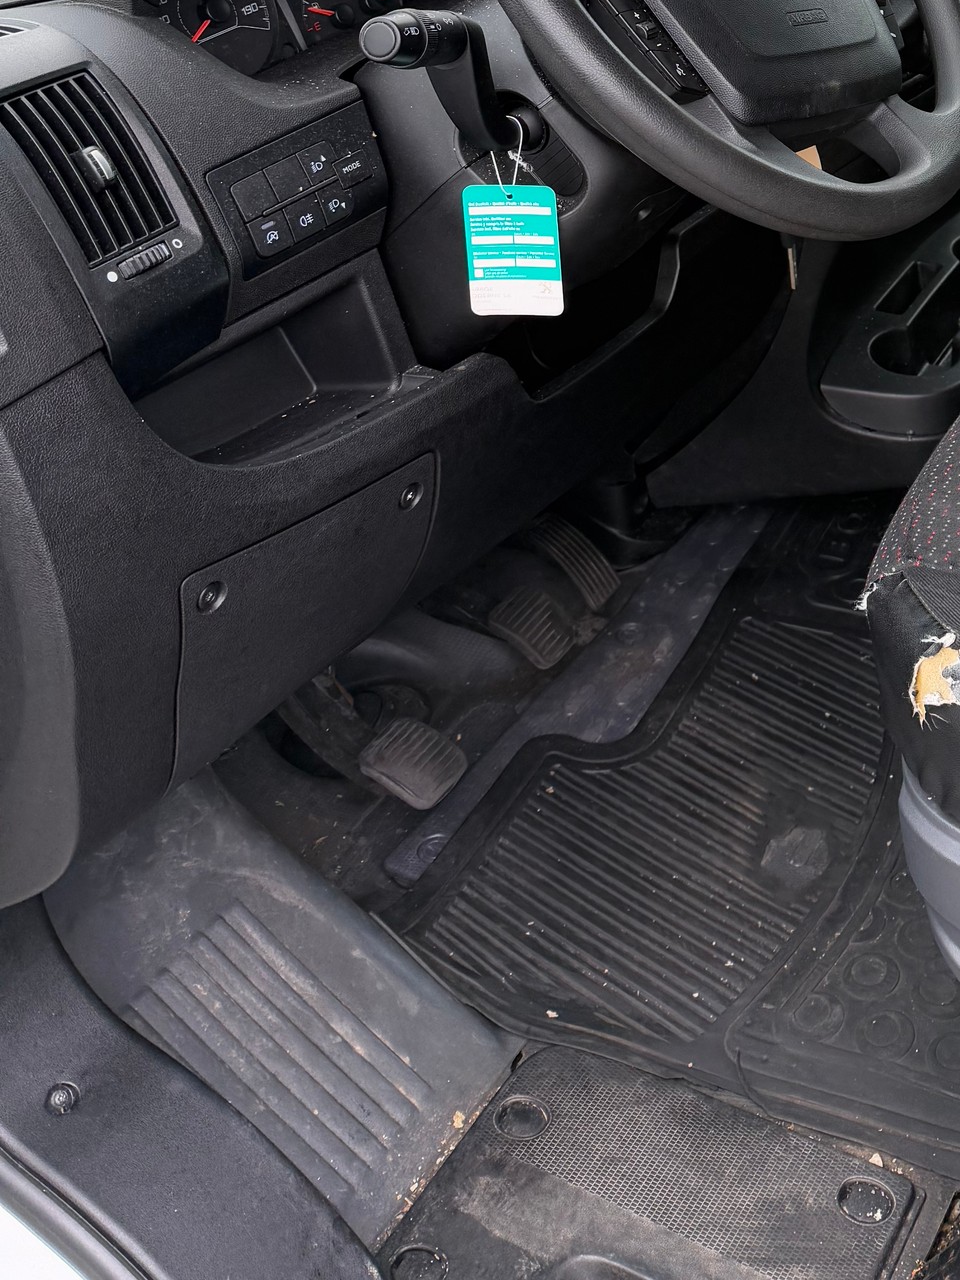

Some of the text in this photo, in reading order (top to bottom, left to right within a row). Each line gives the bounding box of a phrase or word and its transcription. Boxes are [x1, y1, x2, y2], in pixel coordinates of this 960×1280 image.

[241, 2, 259, 16] 190
[313, 21, 321, 31] E
[342, 160, 362, 174] MODE
